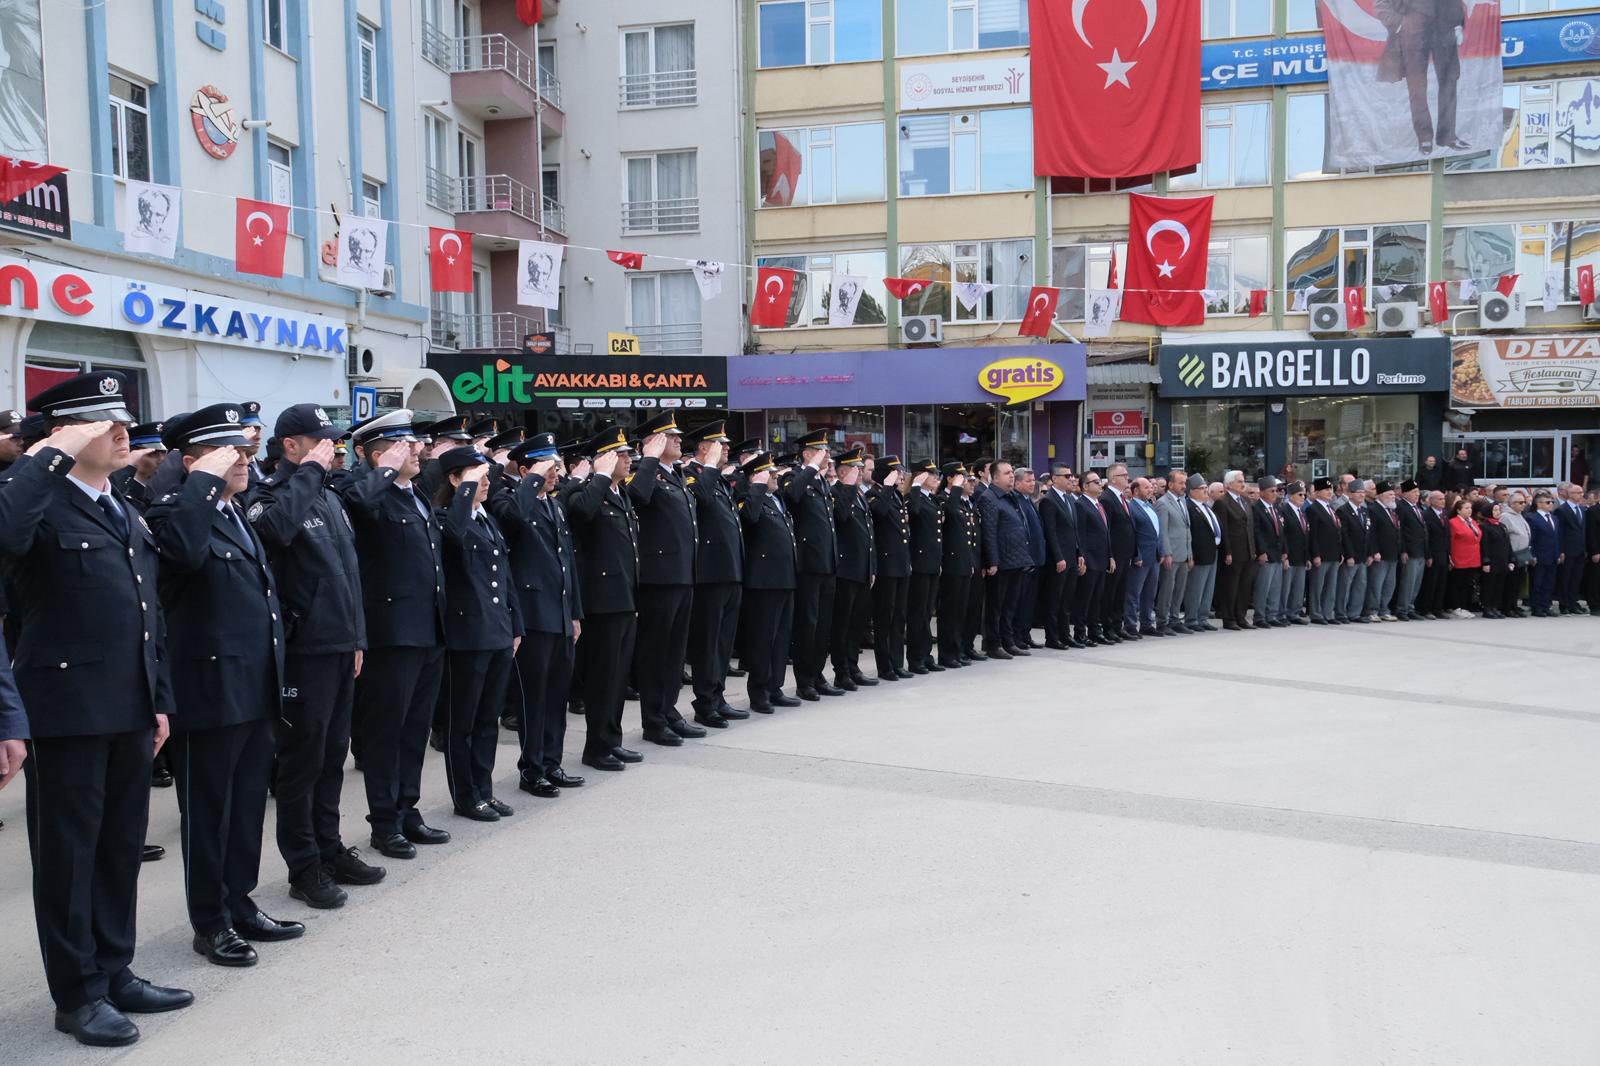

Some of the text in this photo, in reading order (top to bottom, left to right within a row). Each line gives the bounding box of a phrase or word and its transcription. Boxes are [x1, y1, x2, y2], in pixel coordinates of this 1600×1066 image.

[1232, 49, 1258, 58] T.C.
[933, 87, 955, 95] SOSYAL
[955, 85, 977, 93] HİZMET
[121, 280, 346, 354] ÖZKAYNAK
[611, 339, 635, 353] CAT
[1505, 338, 1600, 358] DEVA
[987, 361, 1055, 389] gratis
[1212, 348, 1426, 389] BARGELLO Perfume
[1522, 368, 1582, 380] Restaurant
[452, 359, 534, 404] elit
[534, 373, 627, 388] AYAKKABI
[643, 373, 707, 390] ÇANTA
[359, 396, 369, 418] D
[1537, 397, 1560, 406] YEMEK
